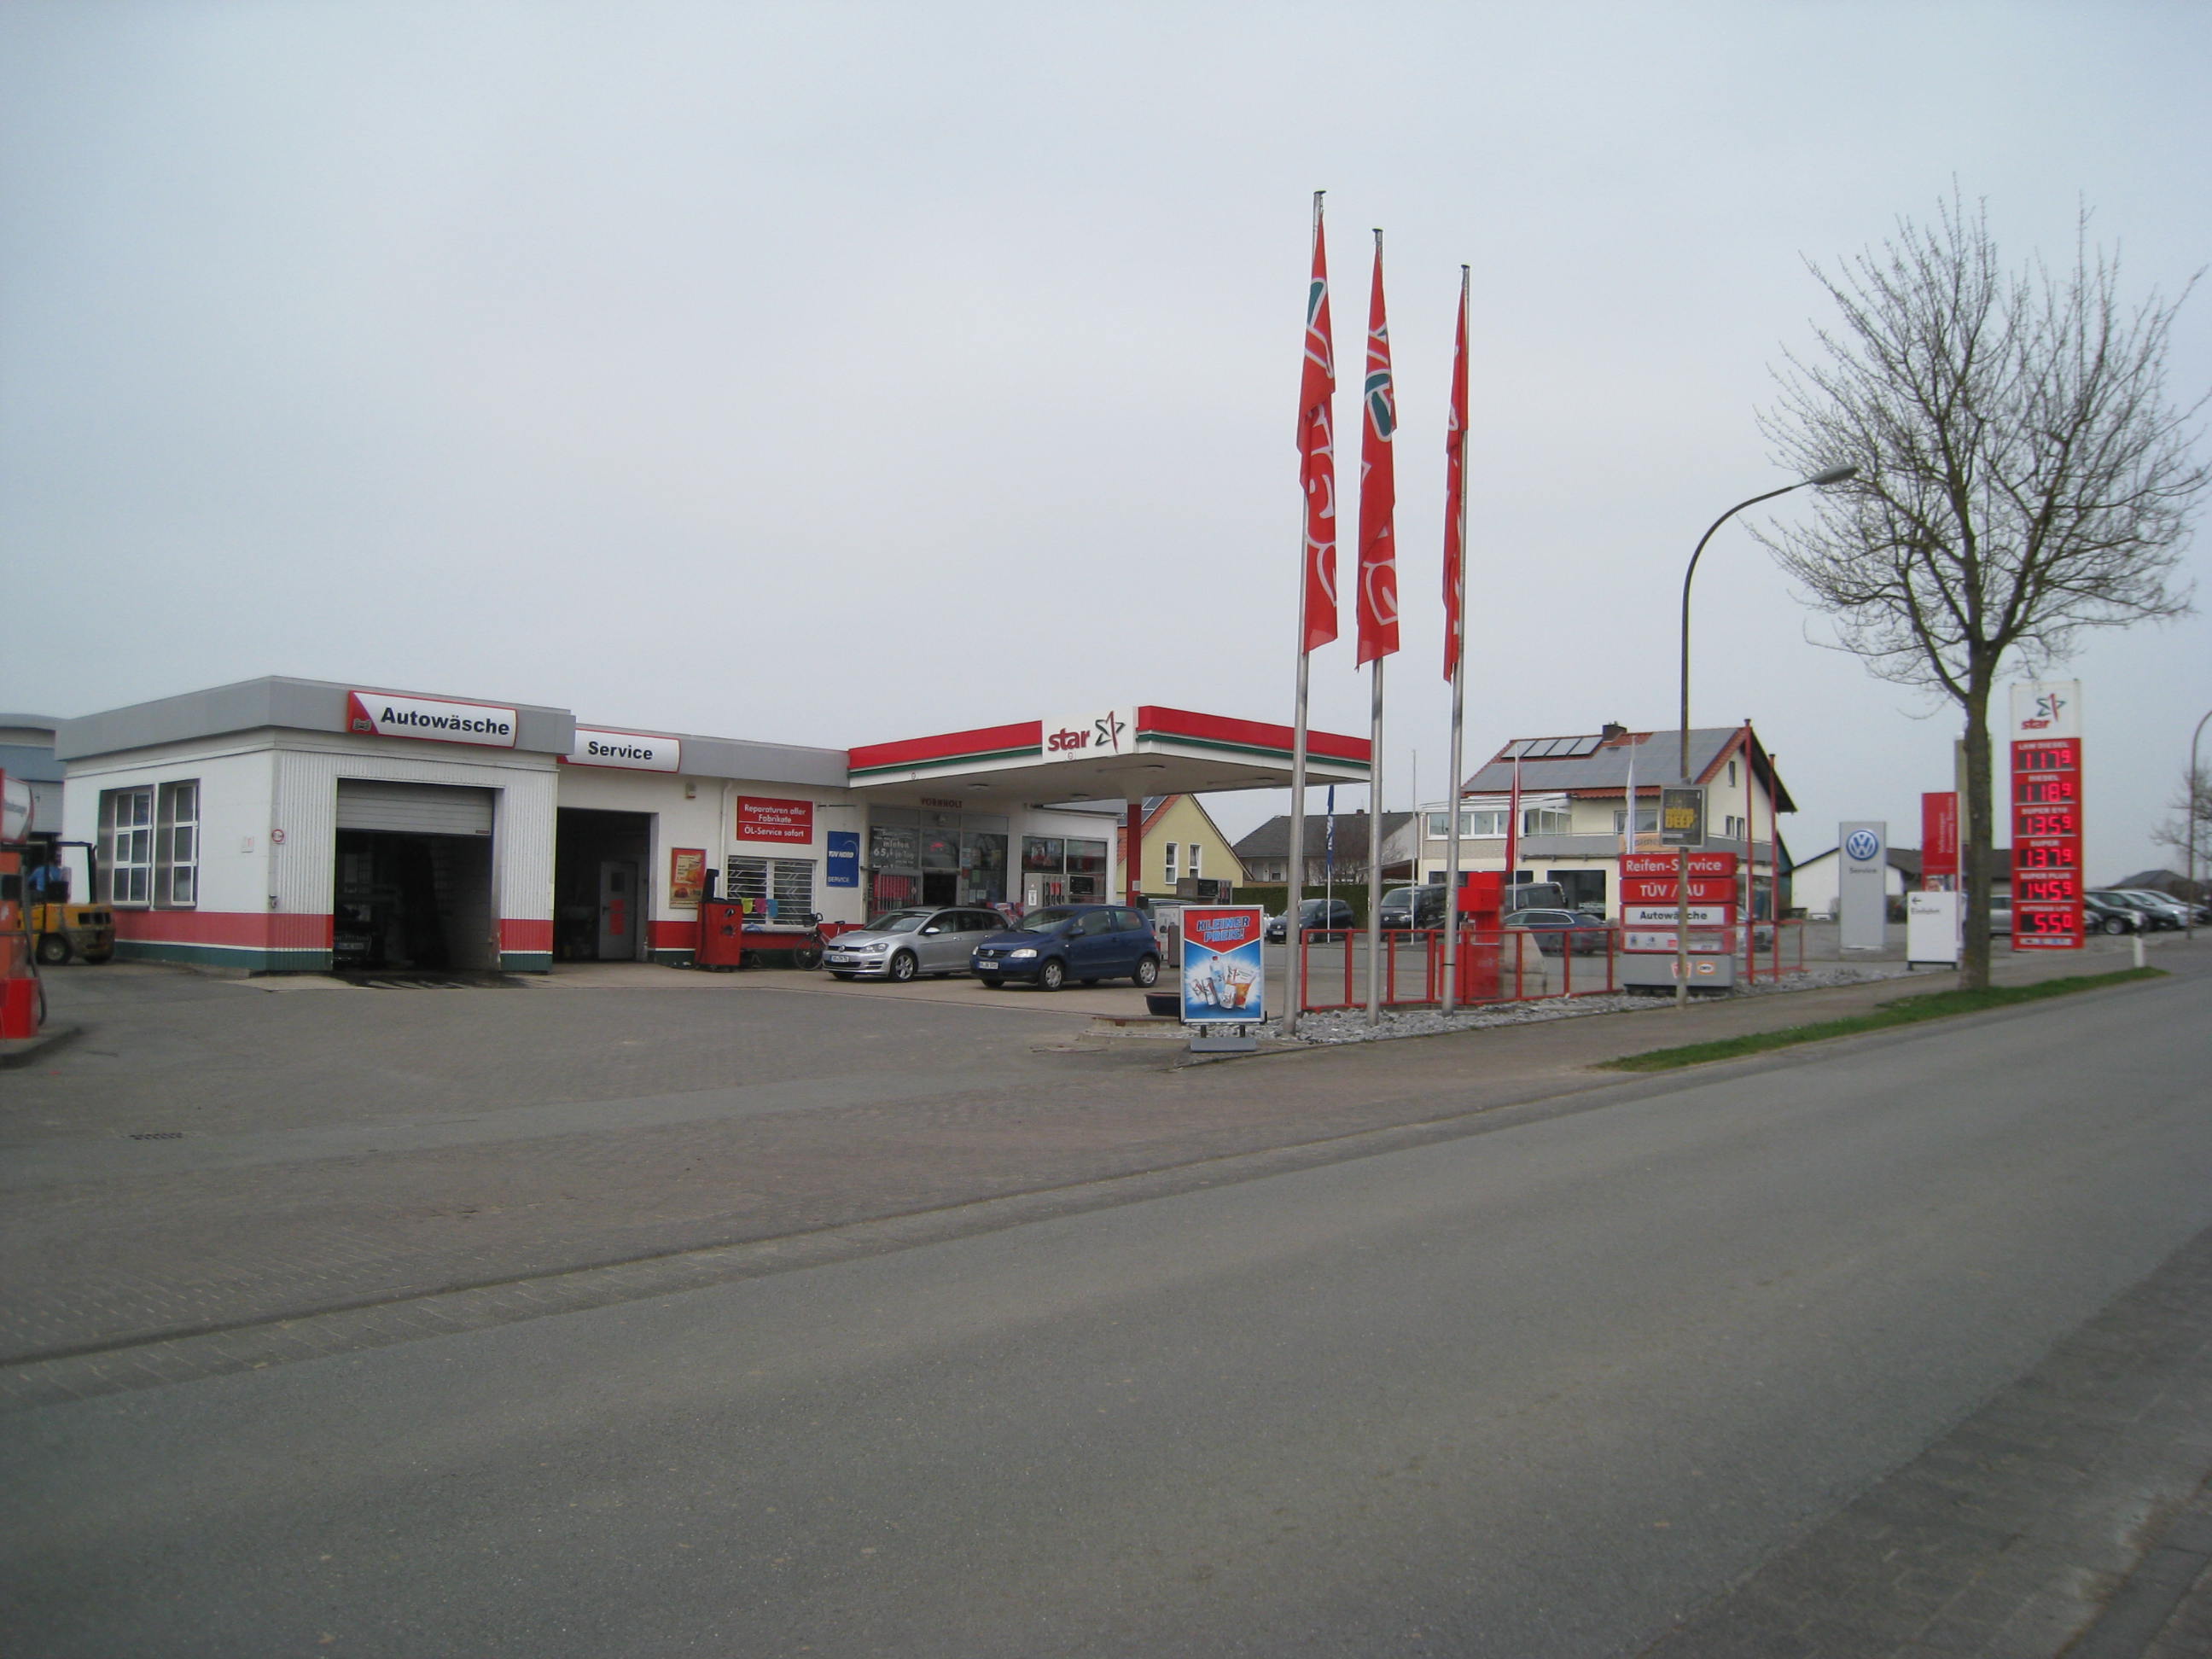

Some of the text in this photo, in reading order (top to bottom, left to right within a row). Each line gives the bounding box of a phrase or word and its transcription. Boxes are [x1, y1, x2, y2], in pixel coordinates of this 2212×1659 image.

[381, 707, 509, 736] Autowäsche
[2021, 718, 2051, 730] star
[1047, 728, 1090, 752] star
[588, 741, 653, 760] Service
[744, 804, 806, 816] Reparaturen aller
[758, 813, 792, 824] Fabrikate
[783, 829, 804, 837] sofort
[1626, 858, 1722, 872] Reifen-Srvice
[1639, 882, 1668, 897] TÜV
[1639, 910, 1708, 921] Autowäche
[1197, 916, 1251, 932] KLEINER
